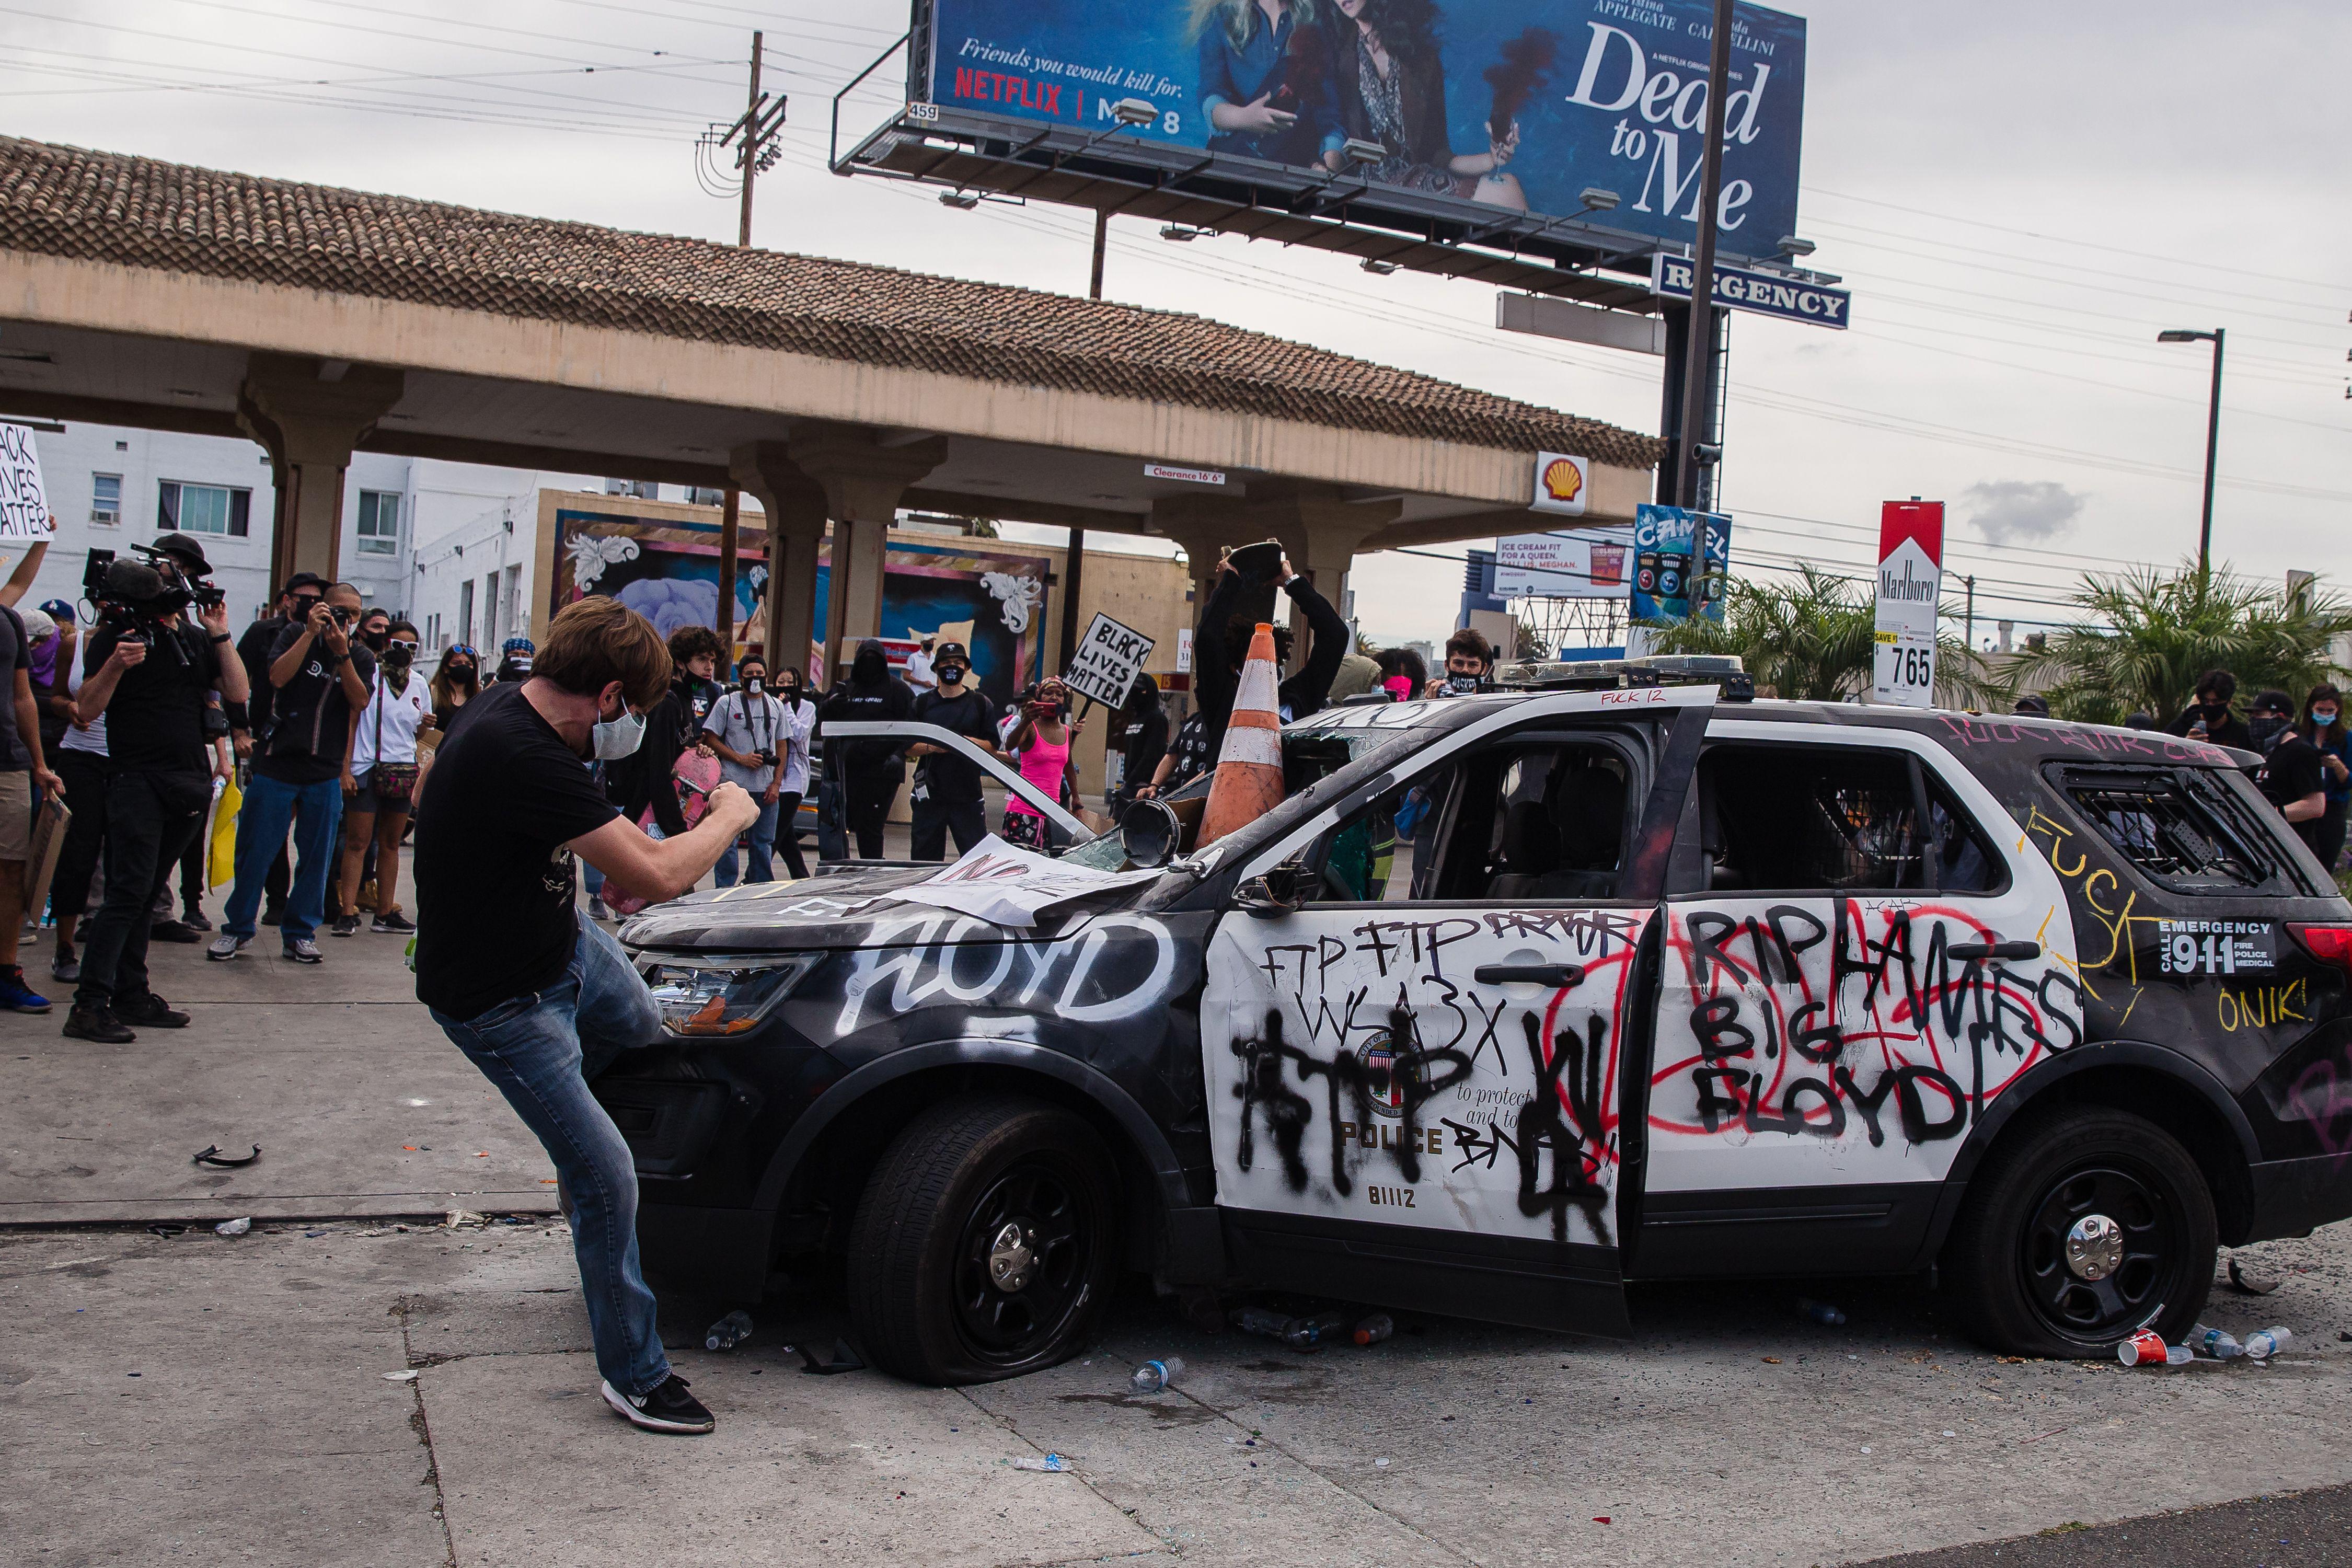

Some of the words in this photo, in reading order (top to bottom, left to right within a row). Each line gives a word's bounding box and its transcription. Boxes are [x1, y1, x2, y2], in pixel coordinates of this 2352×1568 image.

[1594, 1, 1677, 31] APPLEGATE
[959, 37, 1032, 67] Friends
[1030, 56, 1065, 75] you
[1066, 65, 1123, 86] would
[1124, 70, 1155, 93] kill
[1150, 77, 1182, 98] for.
[1659, 54, 1687, 68] NETFLIX
[955, 67, 1062, 116] NETFLIX
[1565, 20, 1770, 145] Dead
[909, 103, 937, 120] 459
[1163, 111, 1180, 135] 8
[1610, 119, 1646, 160] to
[1631, 129, 1753, 231] Me
[1153, 467, 1197, 480] Clearance
[1528, 552, 1558, 561] QUEEN.
[1637, 517, 1726, 560] CAMEL
[1880, 560, 1933, 602] Marlboro
[1095, 622, 1149, 667] BLACK
[1079, 644, 1130, 683] LIVES
[1064, 664, 1124, 706] MATTER
[1601, 691, 1639, 705] FUCK
[1647, 690, 1666, 704] 12
[1939, 716, 2049, 746] FUCK
[1865, 898, 1923, 916] ACAB
[2159, 920, 2270, 935] EMERGENCY
[1353, 919, 1481, 982] FTP
[1687, 904, 1827, 988] RIP
[2161, 934, 2171, 972] CALL
[2173, 935, 2235, 974] 9-1-1
[1260, 934, 1347, 996] FTP
[1360, 1041, 1373, 1057] CITY
[1373, 1034, 1382, 1043] OF
[1690, 996, 1844, 1063] BIG
[1370, 1100, 1398, 1115] FOUNDED
[1476, 1086, 1531, 1108] protect
[1692, 1066, 1967, 1158] FLOYD
[1466, 1106, 1498, 1126] and
[1504, 1109, 1518, 1129] to
[1340, 1121, 1443, 1155] POLICE
[1368, 1185, 1416, 1208] 81112
